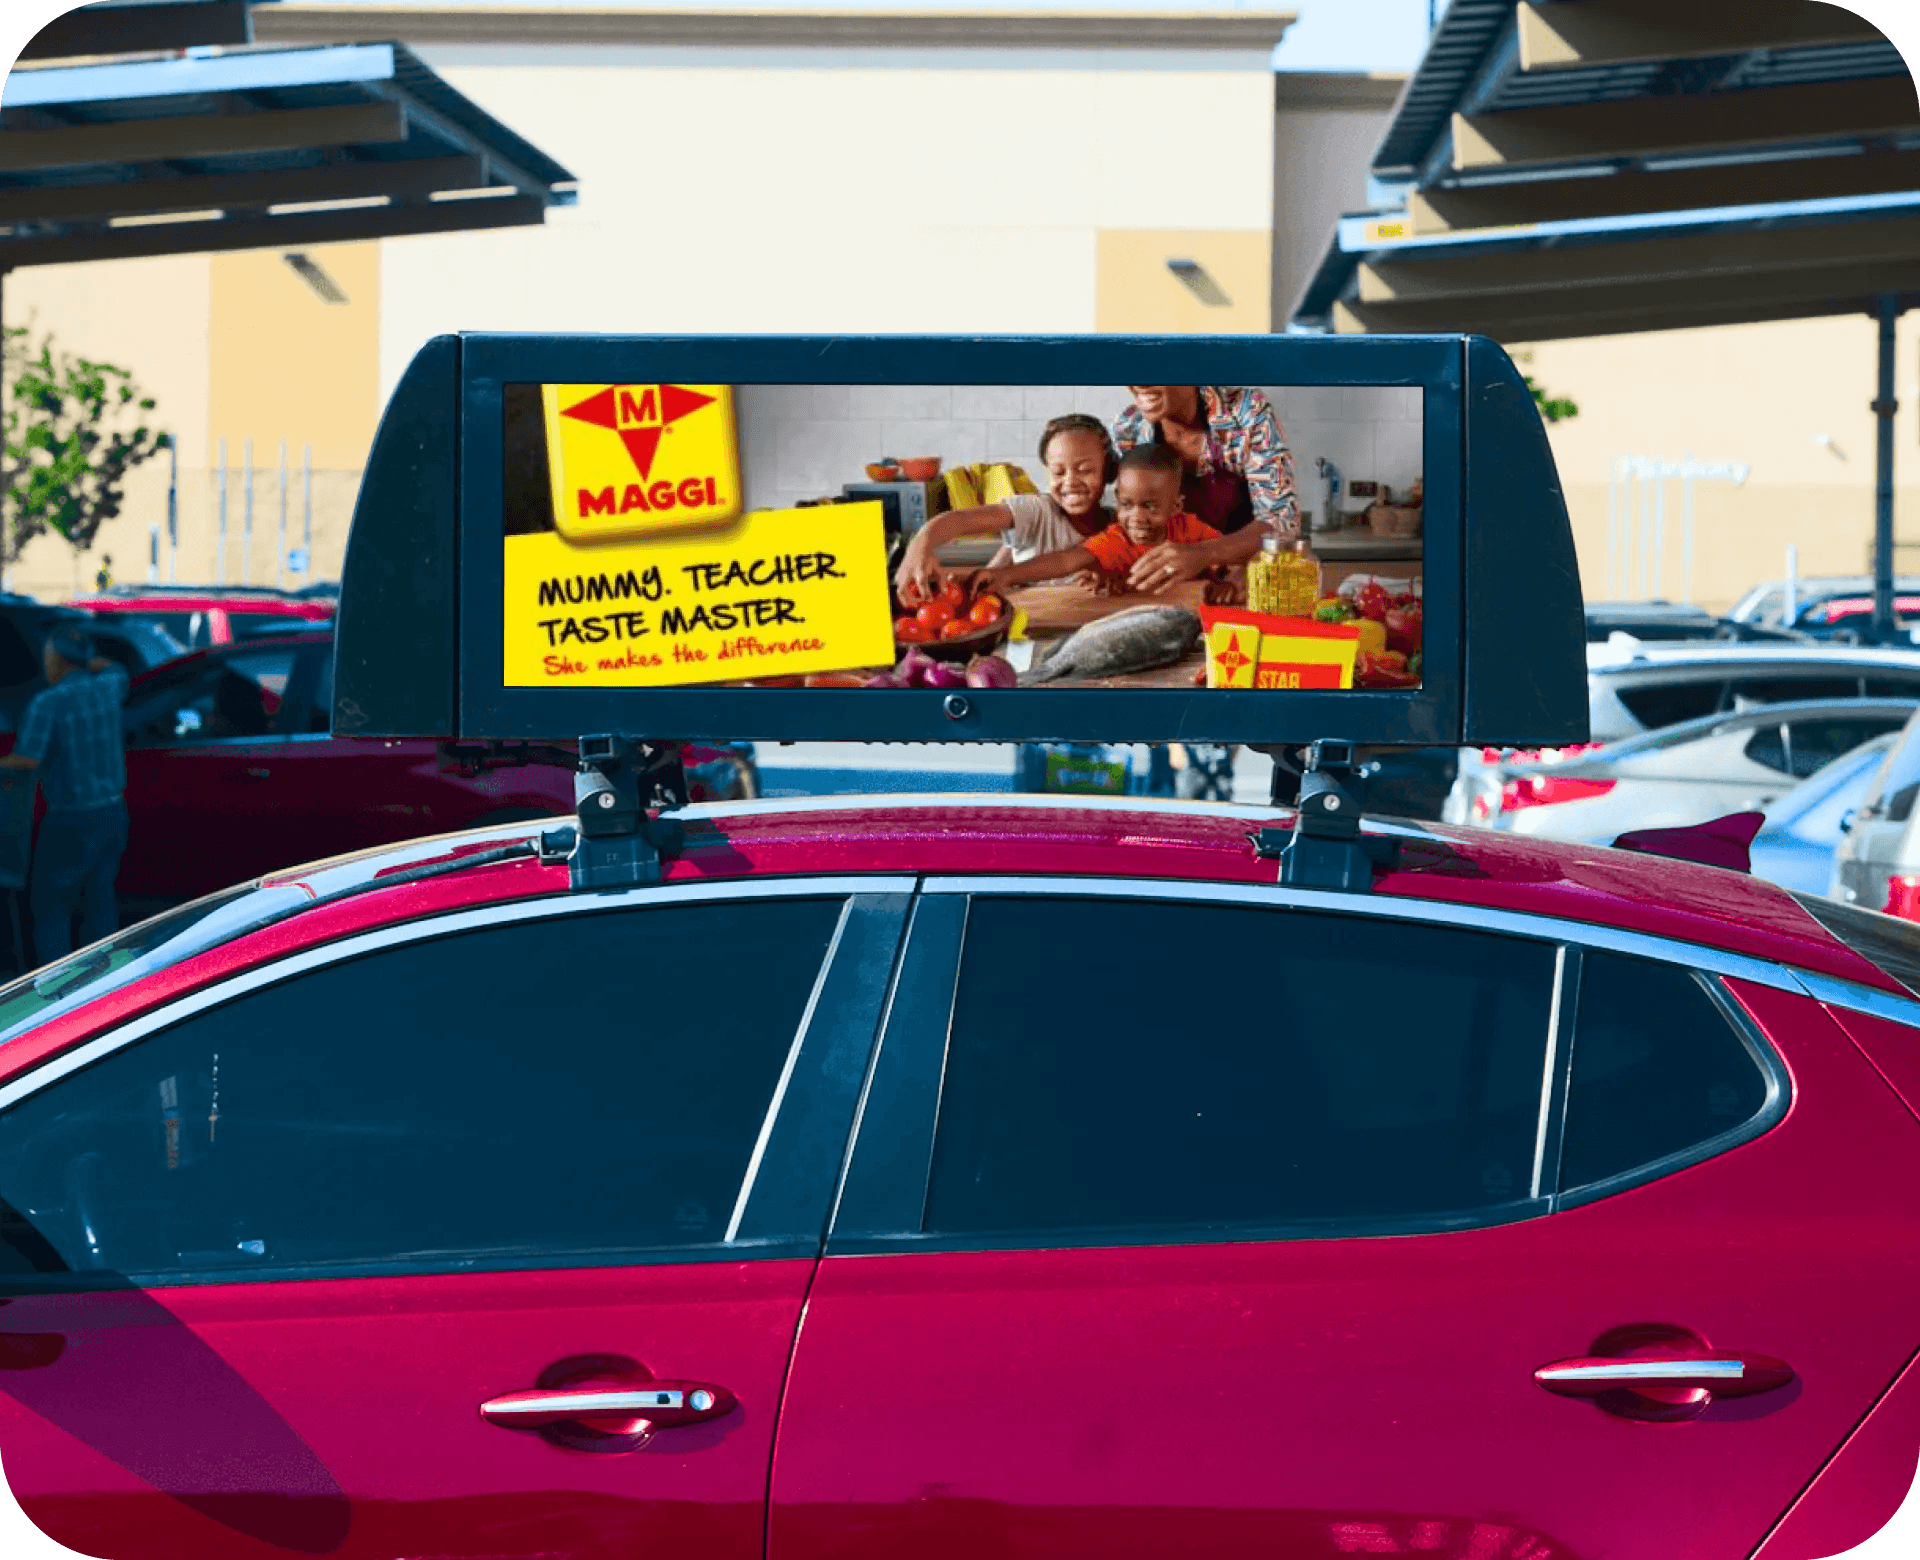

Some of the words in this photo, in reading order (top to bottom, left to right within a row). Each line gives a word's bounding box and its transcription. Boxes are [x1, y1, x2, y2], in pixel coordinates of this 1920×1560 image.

[620, 388, 657, 424] M
[577, 476, 717, 518] MAGGI
[681, 551, 847, 592] TEACHER.
[537, 611, 650, 647] TASTE
[660, 597, 806, 635] MASTER.
[542, 655, 588, 676] She
[597, 646, 663, 671] makes
[672, 643, 708, 663] the
[717, 635, 825, 661] difference
